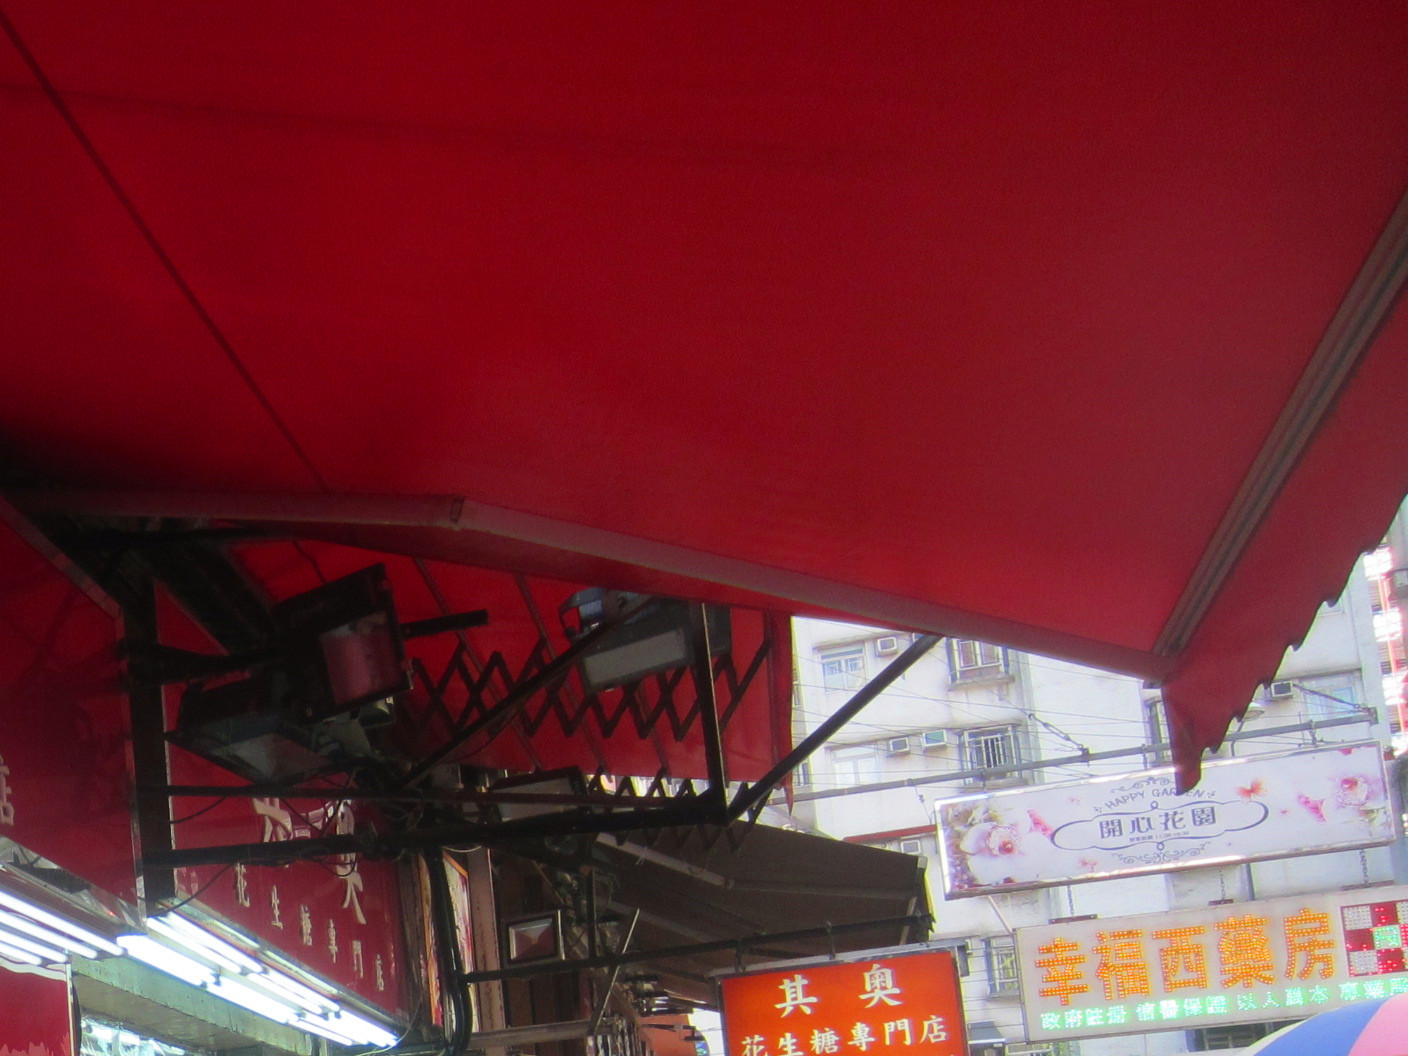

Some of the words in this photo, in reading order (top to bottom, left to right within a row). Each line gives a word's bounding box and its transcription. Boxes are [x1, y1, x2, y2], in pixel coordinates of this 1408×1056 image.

[1105, 792, 1146, 810] HAPPY
[1152, 787, 1205, 799] GAREN
[1099, 806, 1216, 840] 開心花園
[1035, 907, 1336, 1006] 幸福西藥房
